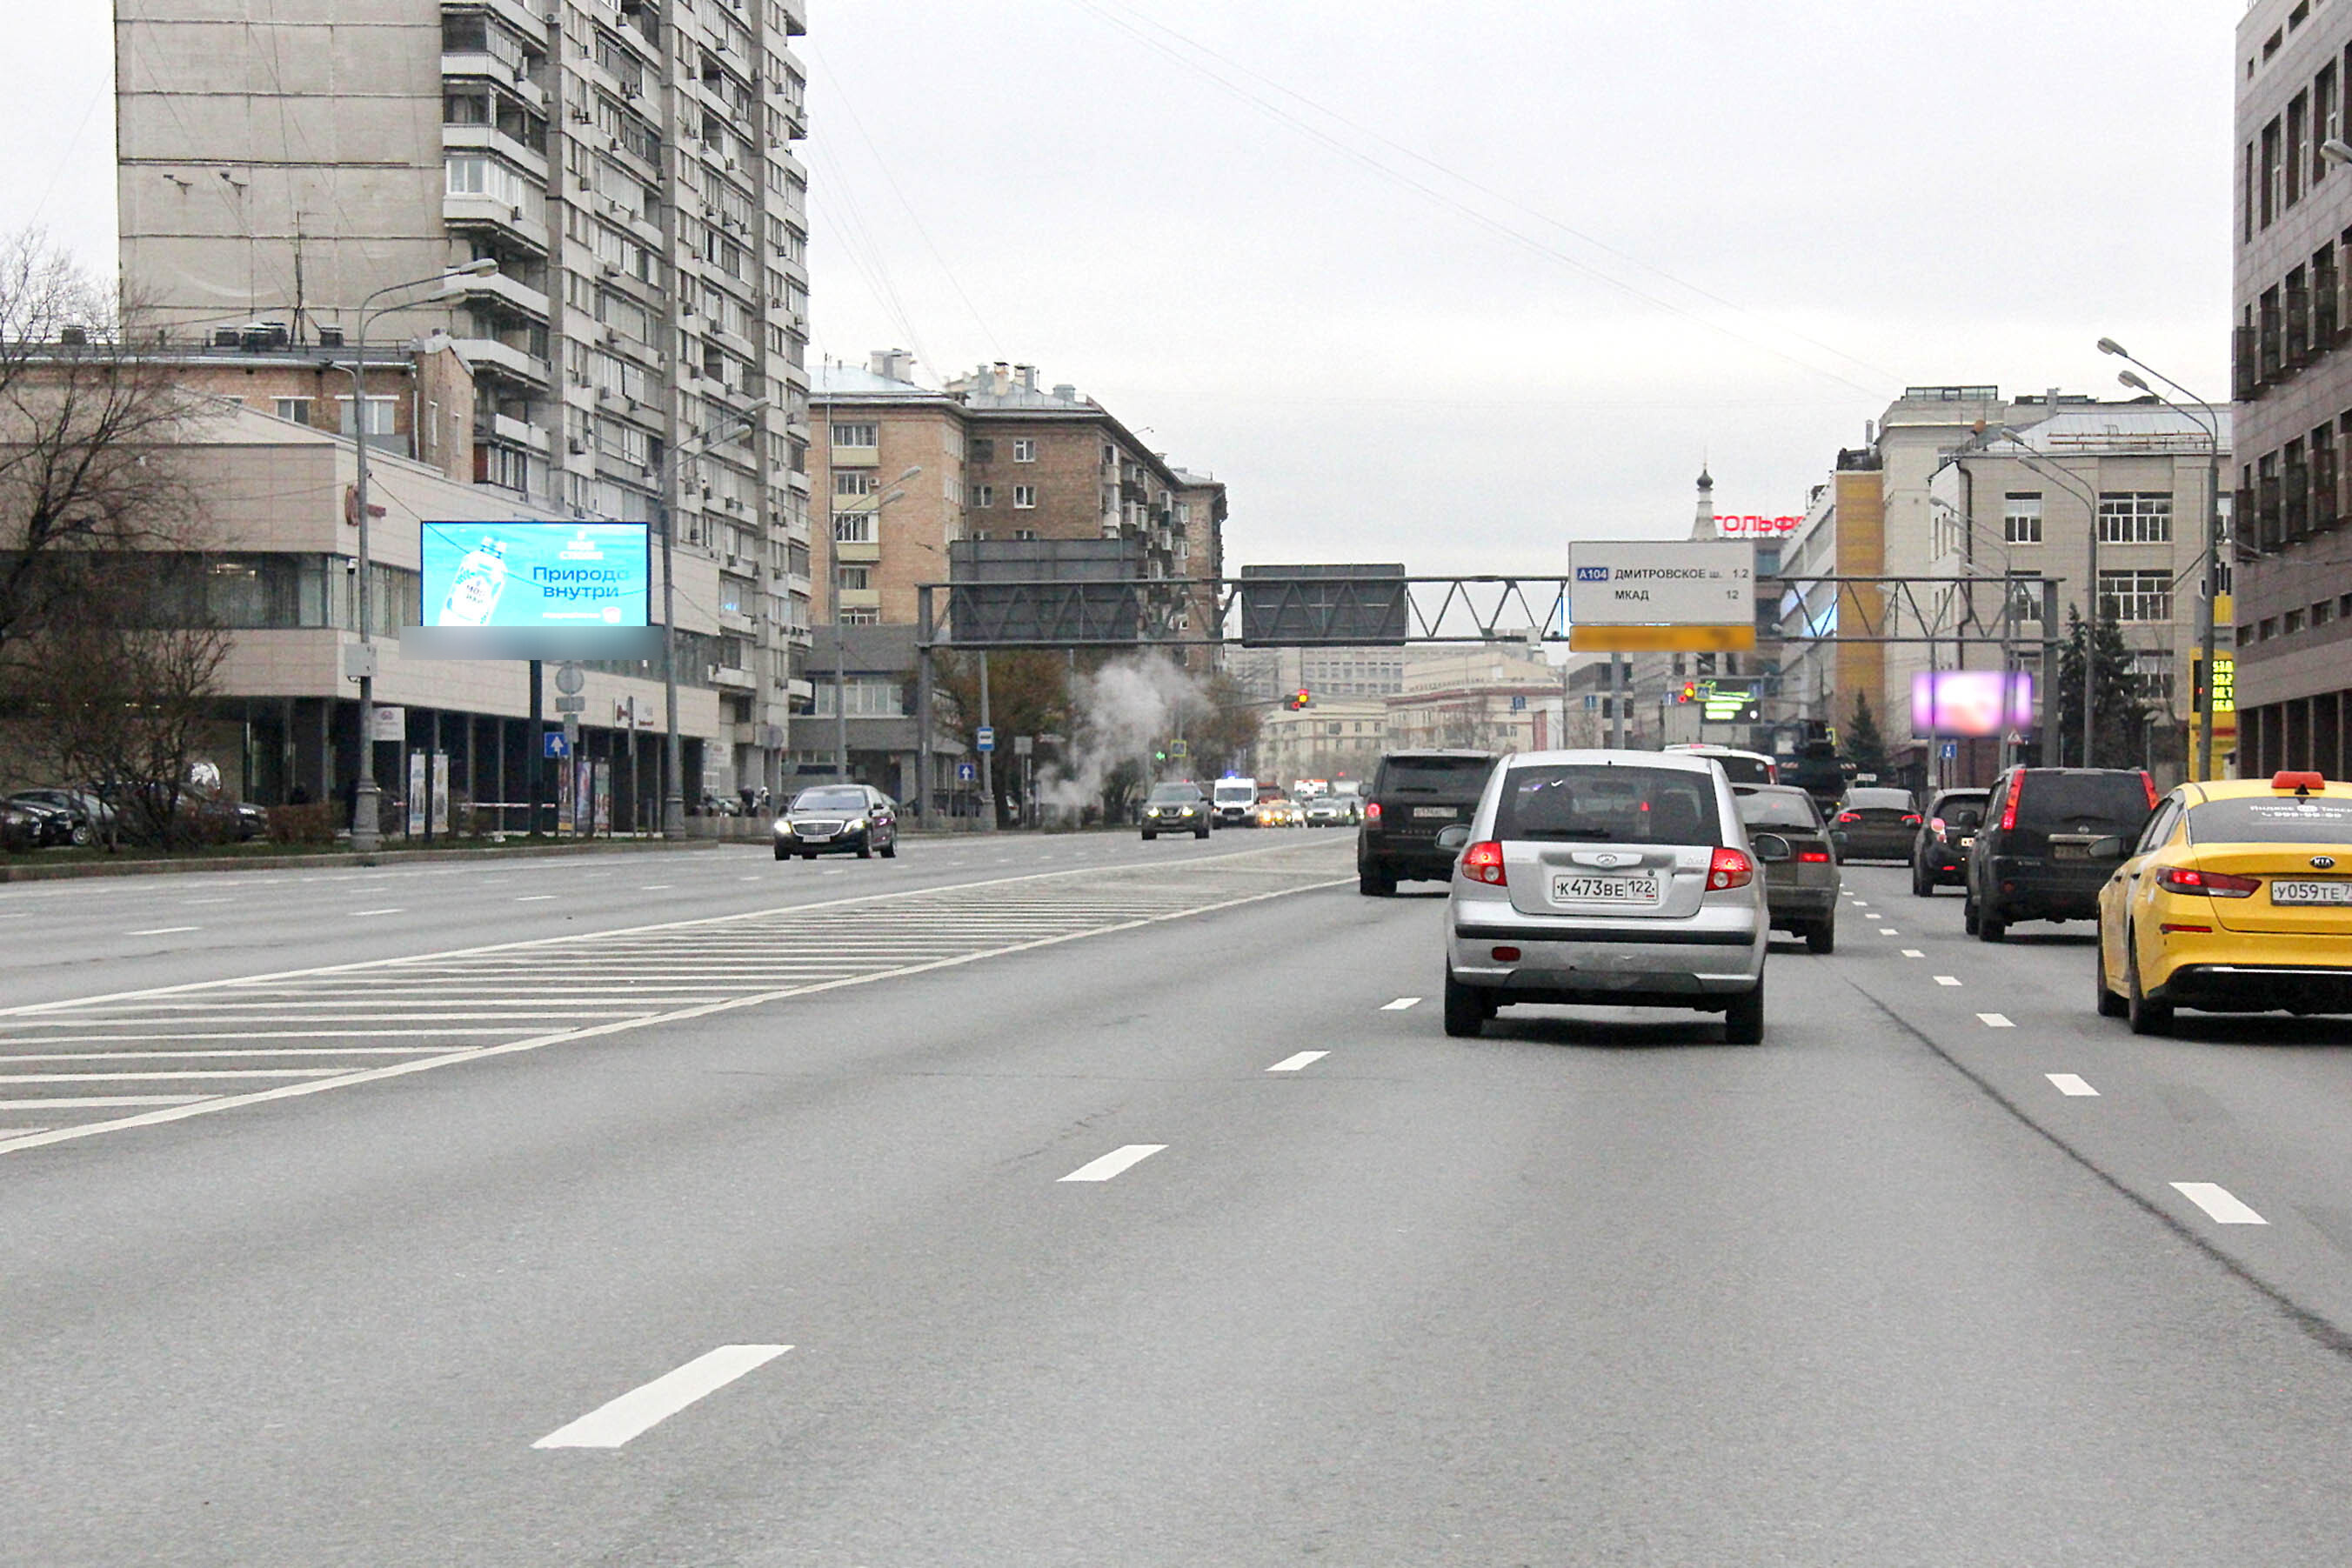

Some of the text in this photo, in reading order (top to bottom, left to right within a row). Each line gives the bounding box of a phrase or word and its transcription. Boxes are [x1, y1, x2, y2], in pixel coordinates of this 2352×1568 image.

[1579, 569, 1607, 579] А104
[1615, 569, 1705, 582] ДМИТРОВСКОЕ
[544, 586, 619, 600] внутри
[1615, 590, 1739, 601] МКАД 12
[1560, 879, 1652, 897] К473ВЕ 122
[2278, 884, 2340, 899] У059ТЕ
